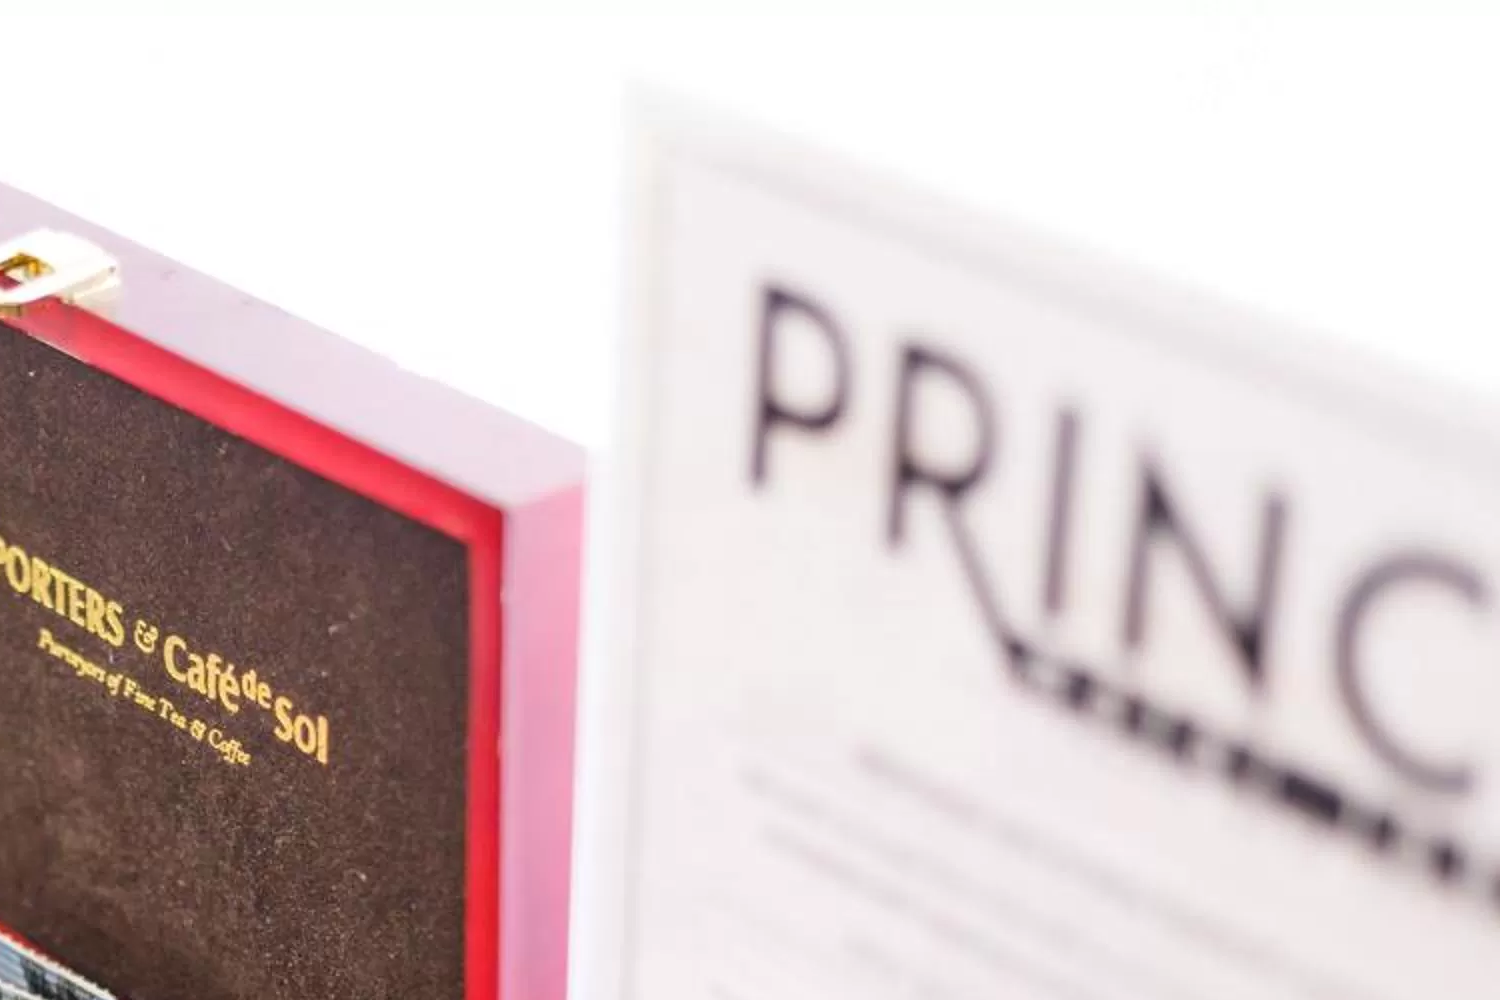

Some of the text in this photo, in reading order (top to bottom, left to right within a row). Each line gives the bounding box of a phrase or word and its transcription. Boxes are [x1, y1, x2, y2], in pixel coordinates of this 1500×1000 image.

[747, 280, 1492, 797] PRINC
[133, 618, 160, 654] &
[163, 634, 240, 714] Café
[242, 668, 271, 710] de
[106, 673, 124, 696] of
[123, 677, 157, 712] Fine
[159, 697, 188, 730] Tea
[189, 718, 208, 741] &
[208, 728, 252, 767] Coffee
